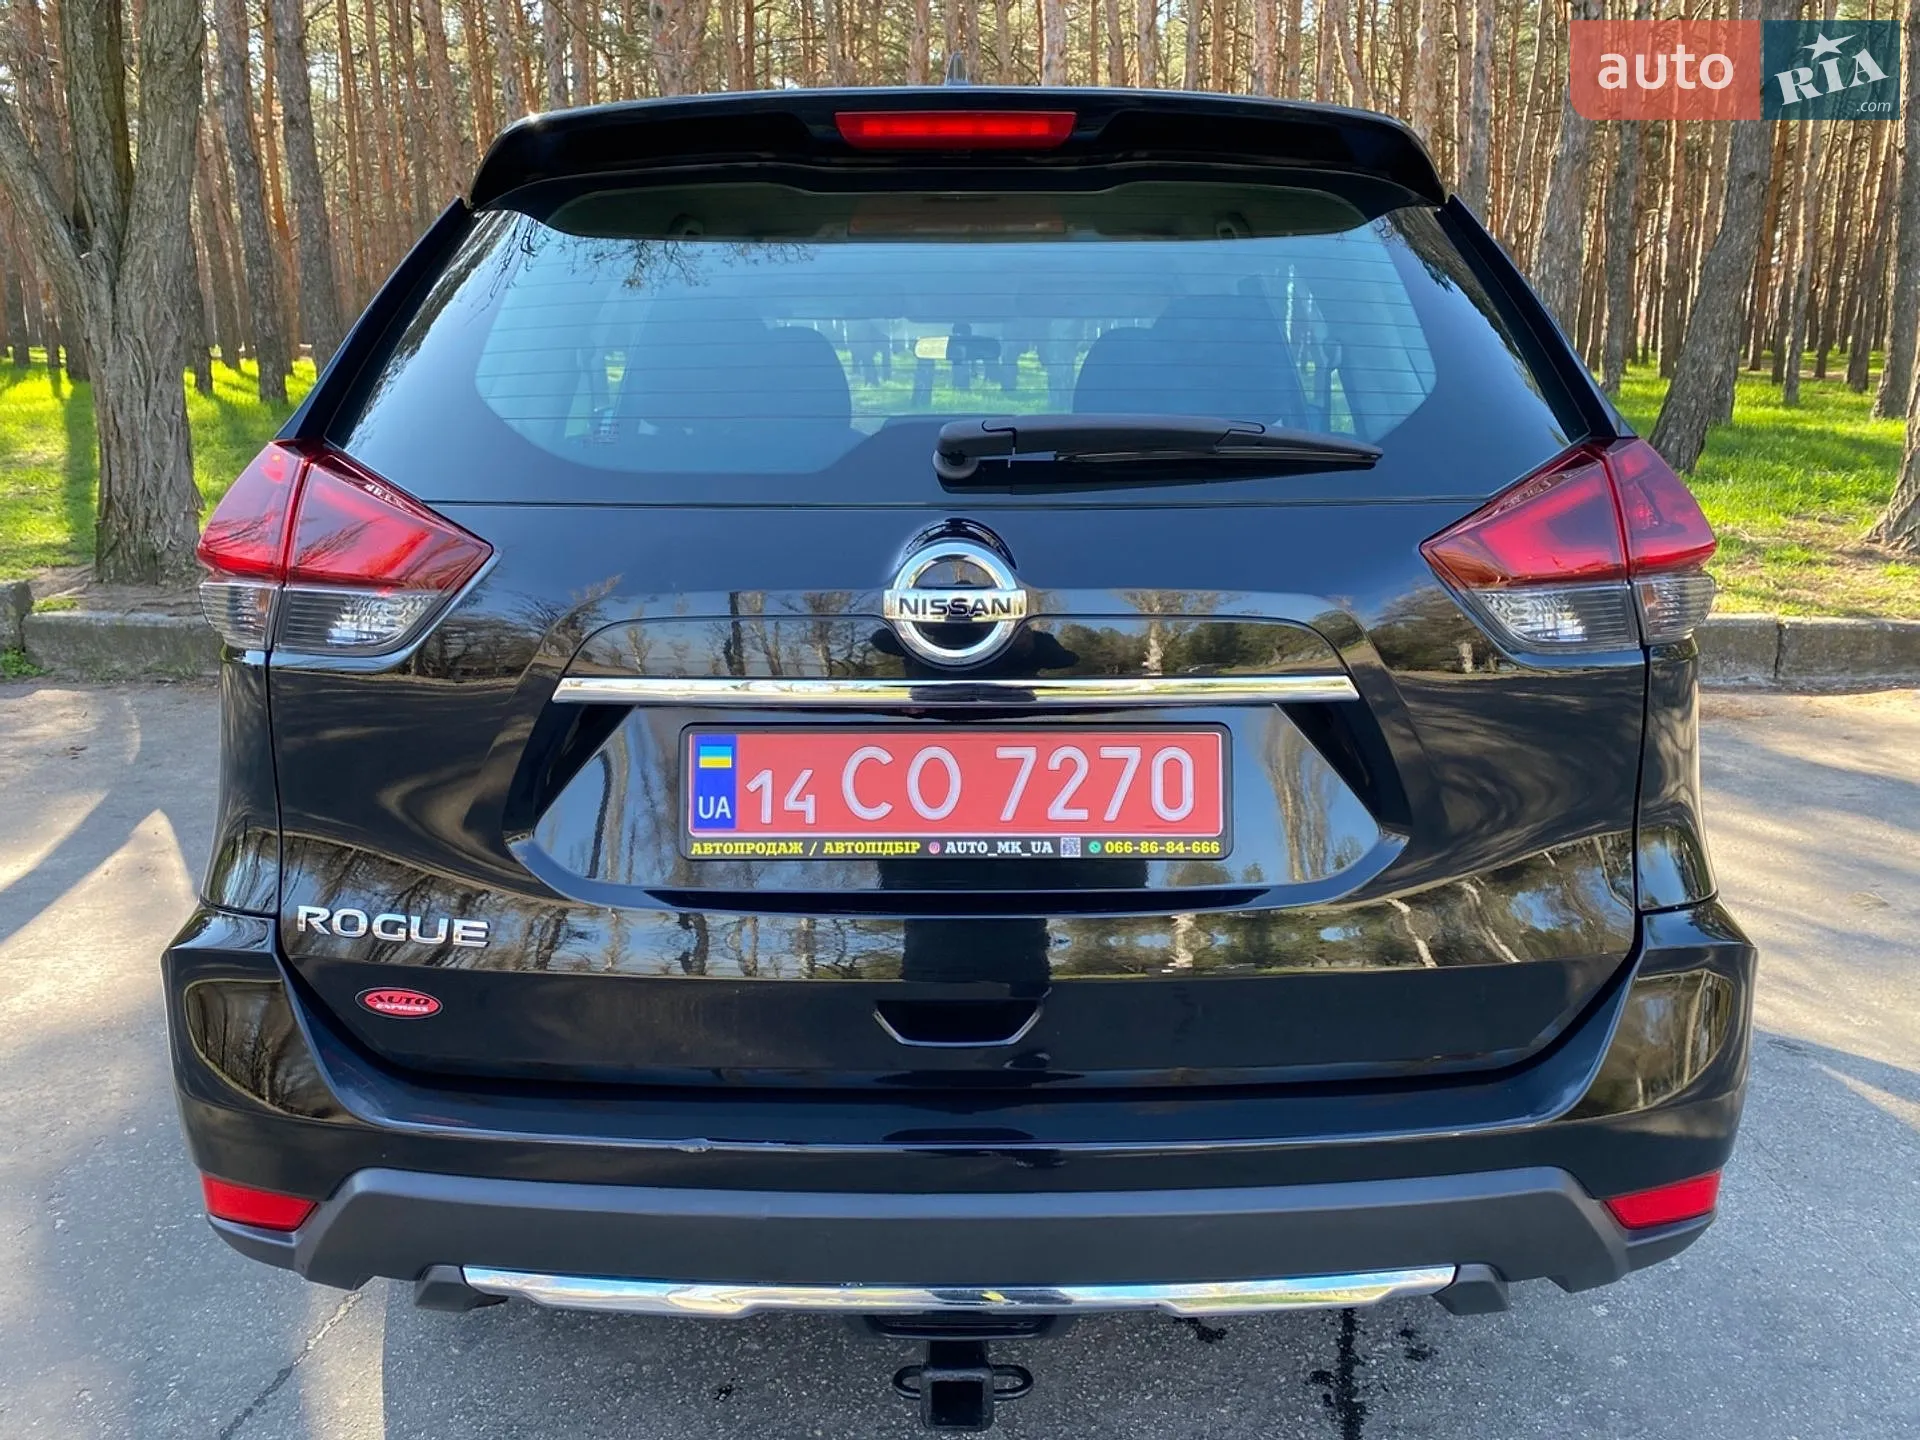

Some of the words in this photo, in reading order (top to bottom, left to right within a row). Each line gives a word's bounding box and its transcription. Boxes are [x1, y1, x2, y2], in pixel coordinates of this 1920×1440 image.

[898, 597, 1012, 616] NISSAN
[745, 769, 817, 825] 14
[841, 745, 962, 821] CO
[995, 745, 1195, 822] 7270
[698, 796, 732, 819] UA
[690, 841, 804, 856] АВТОПРОДАЖ
[823, 841, 921, 856] АВТОПІДБІР
[945, 841, 1054, 857] AUTO_MK_UA
[1104, 841, 1220, 855] 066-86-84-666
[296, 905, 490, 948] ROGUE
[367, 994, 431, 1006] AUTO
